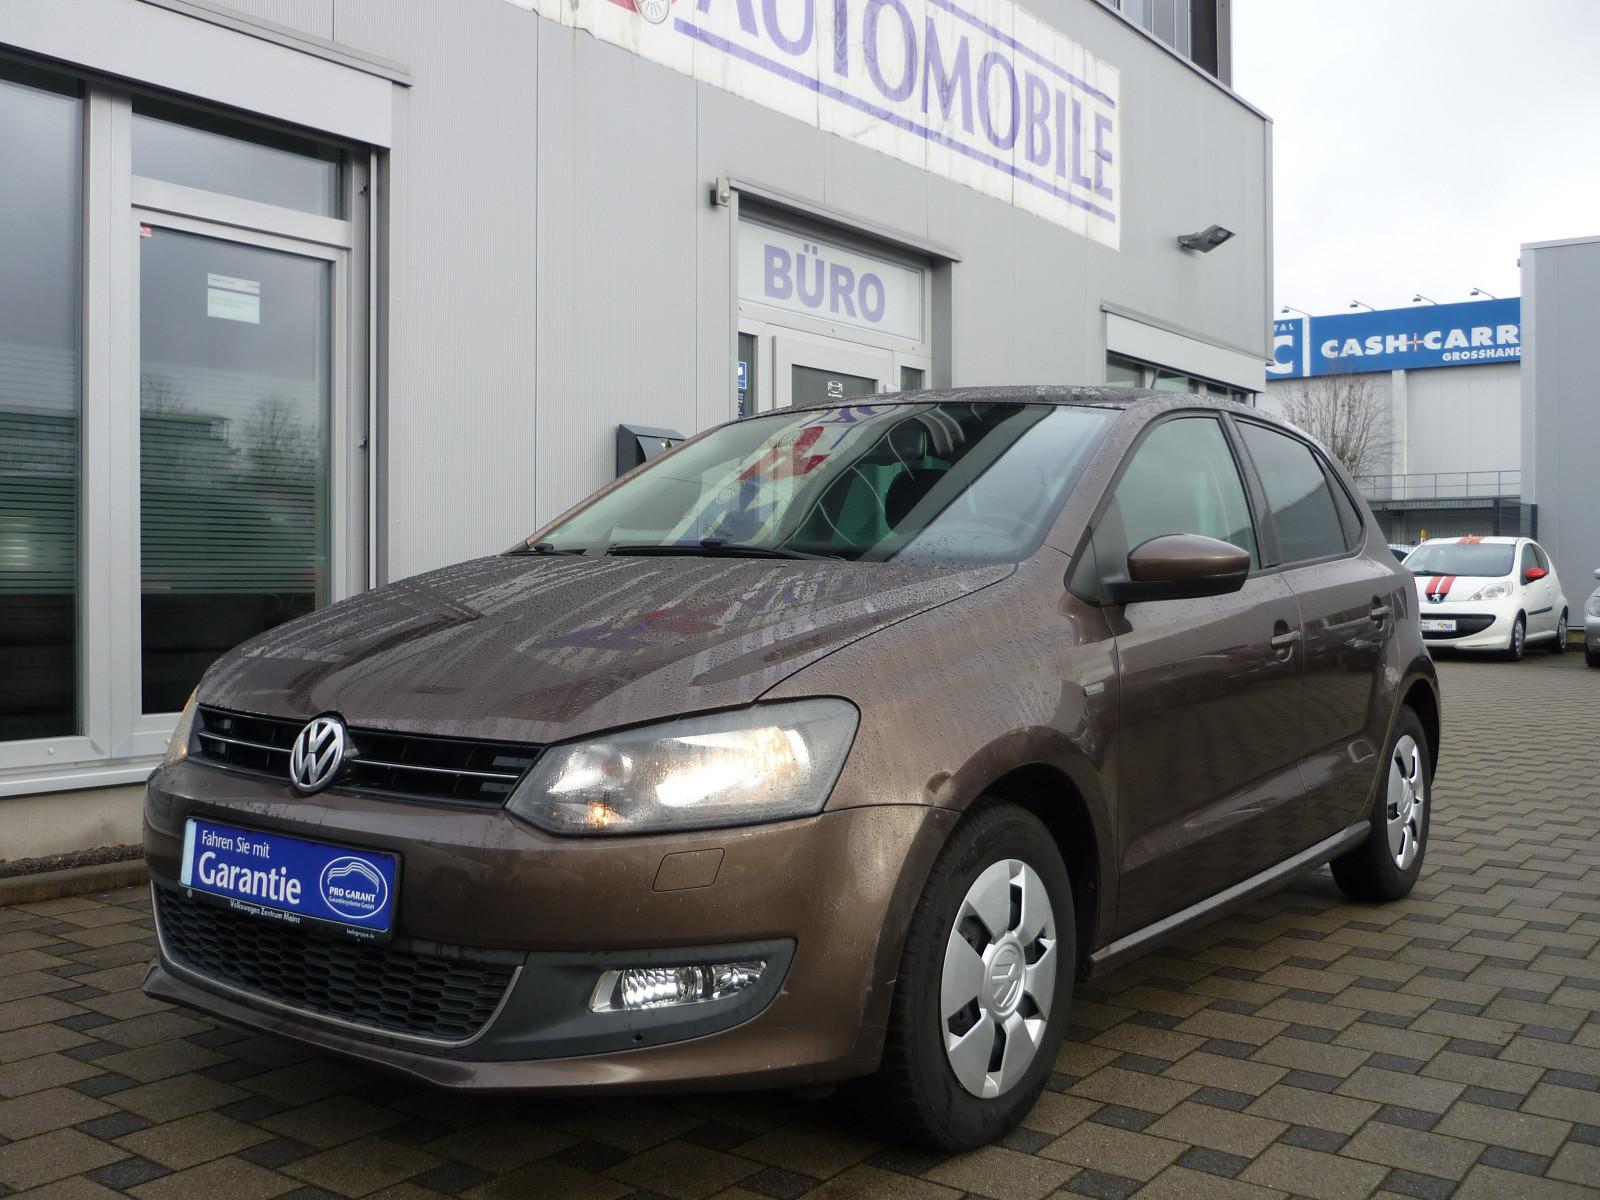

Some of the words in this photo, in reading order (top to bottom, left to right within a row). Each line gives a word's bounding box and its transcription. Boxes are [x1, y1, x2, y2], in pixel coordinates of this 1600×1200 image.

[696, 0, 1113, 200] TOMOBILE
[764, 243, 885, 323] BÜRO
[1320, 324, 1520, 359] CASH+CARR
[202, 830, 233, 851] Fahren
[236, 836, 250, 854] Sie
[252, 841, 270, 859] mit
[199, 851, 301, 904] Garantie
[329, 886, 344, 896] PRO
[345, 889, 376, 903] GARANT
[230, 899, 260, 915] Volkswagen
[260, 907, 283, 919] Zentrum
